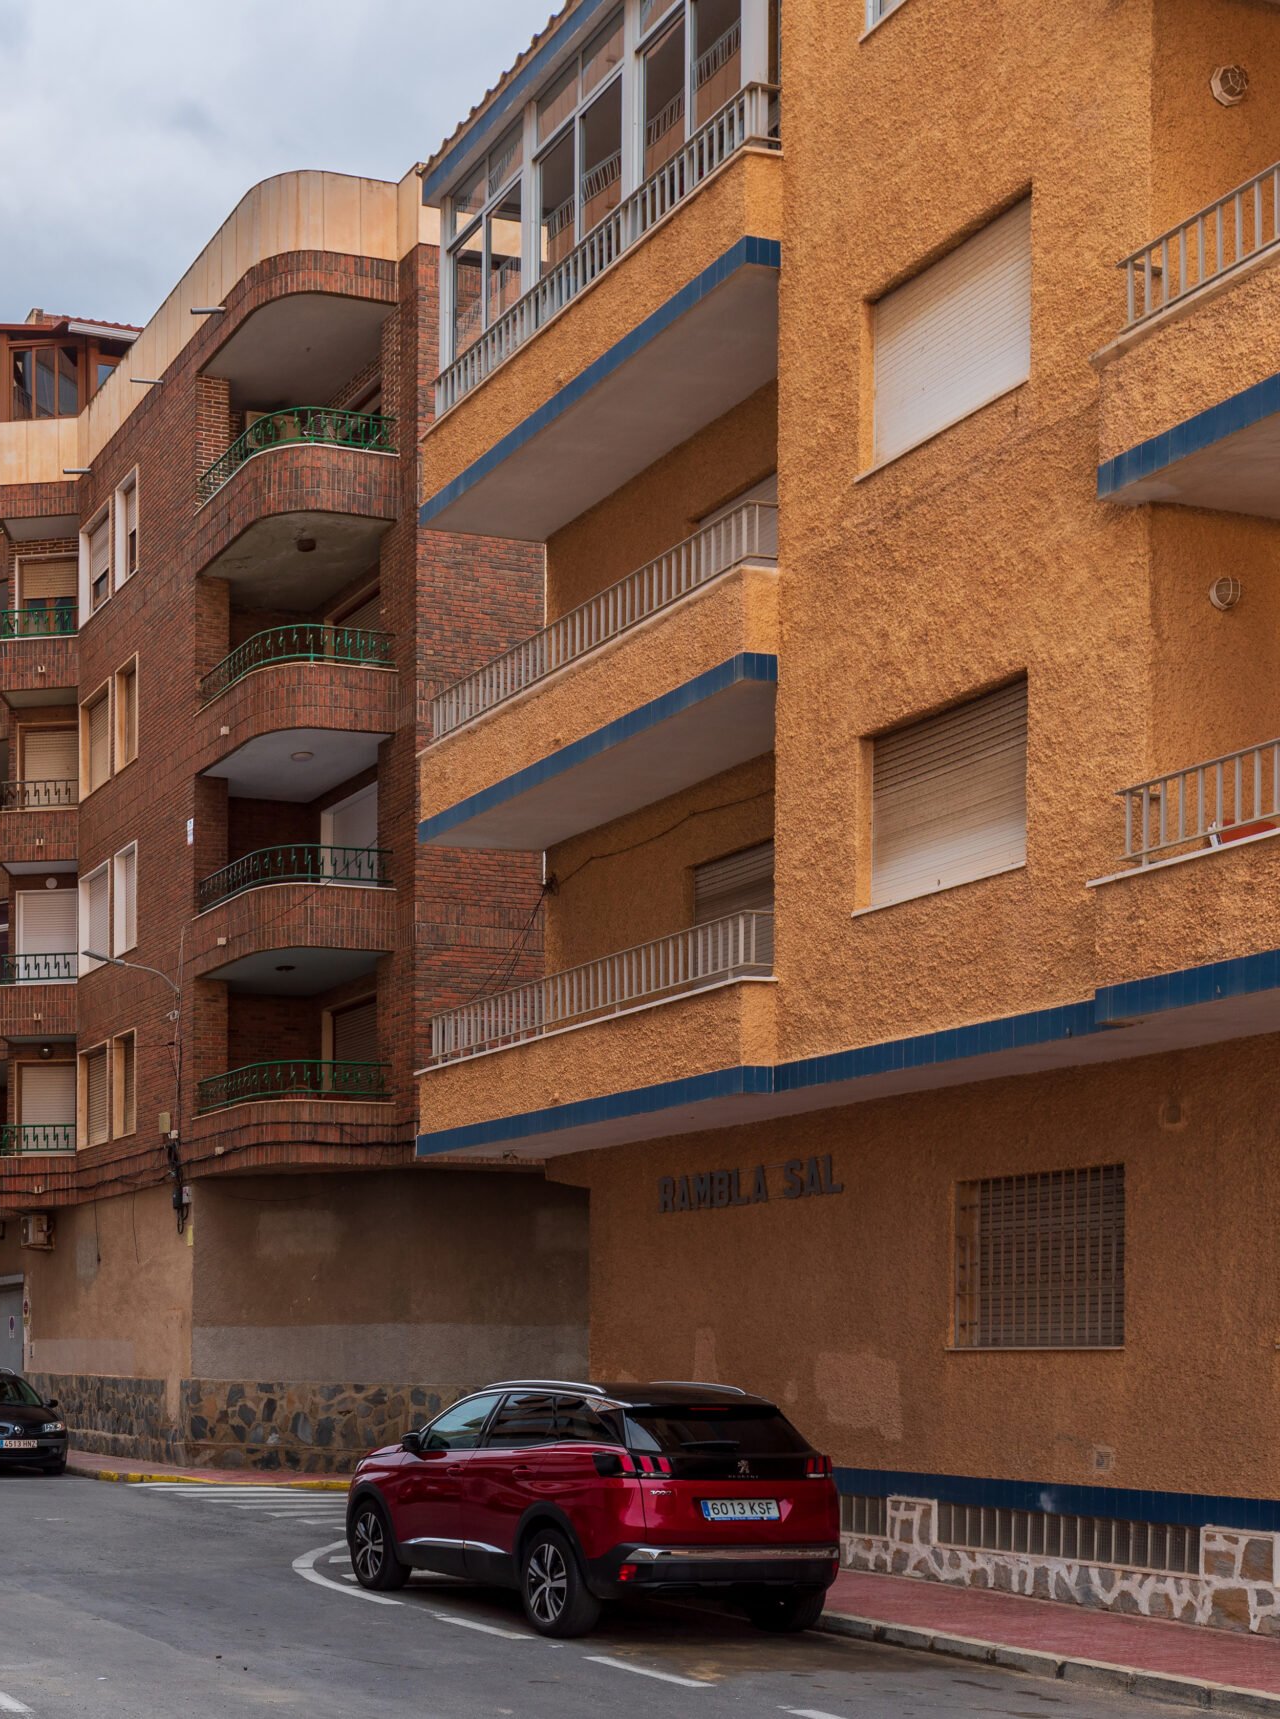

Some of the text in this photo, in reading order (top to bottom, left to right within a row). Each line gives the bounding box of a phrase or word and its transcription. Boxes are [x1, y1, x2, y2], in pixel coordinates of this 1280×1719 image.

[658, 1153, 845, 1214] RAMBLA SAL
[710, 1502, 774, 1516] 6013 KSF
